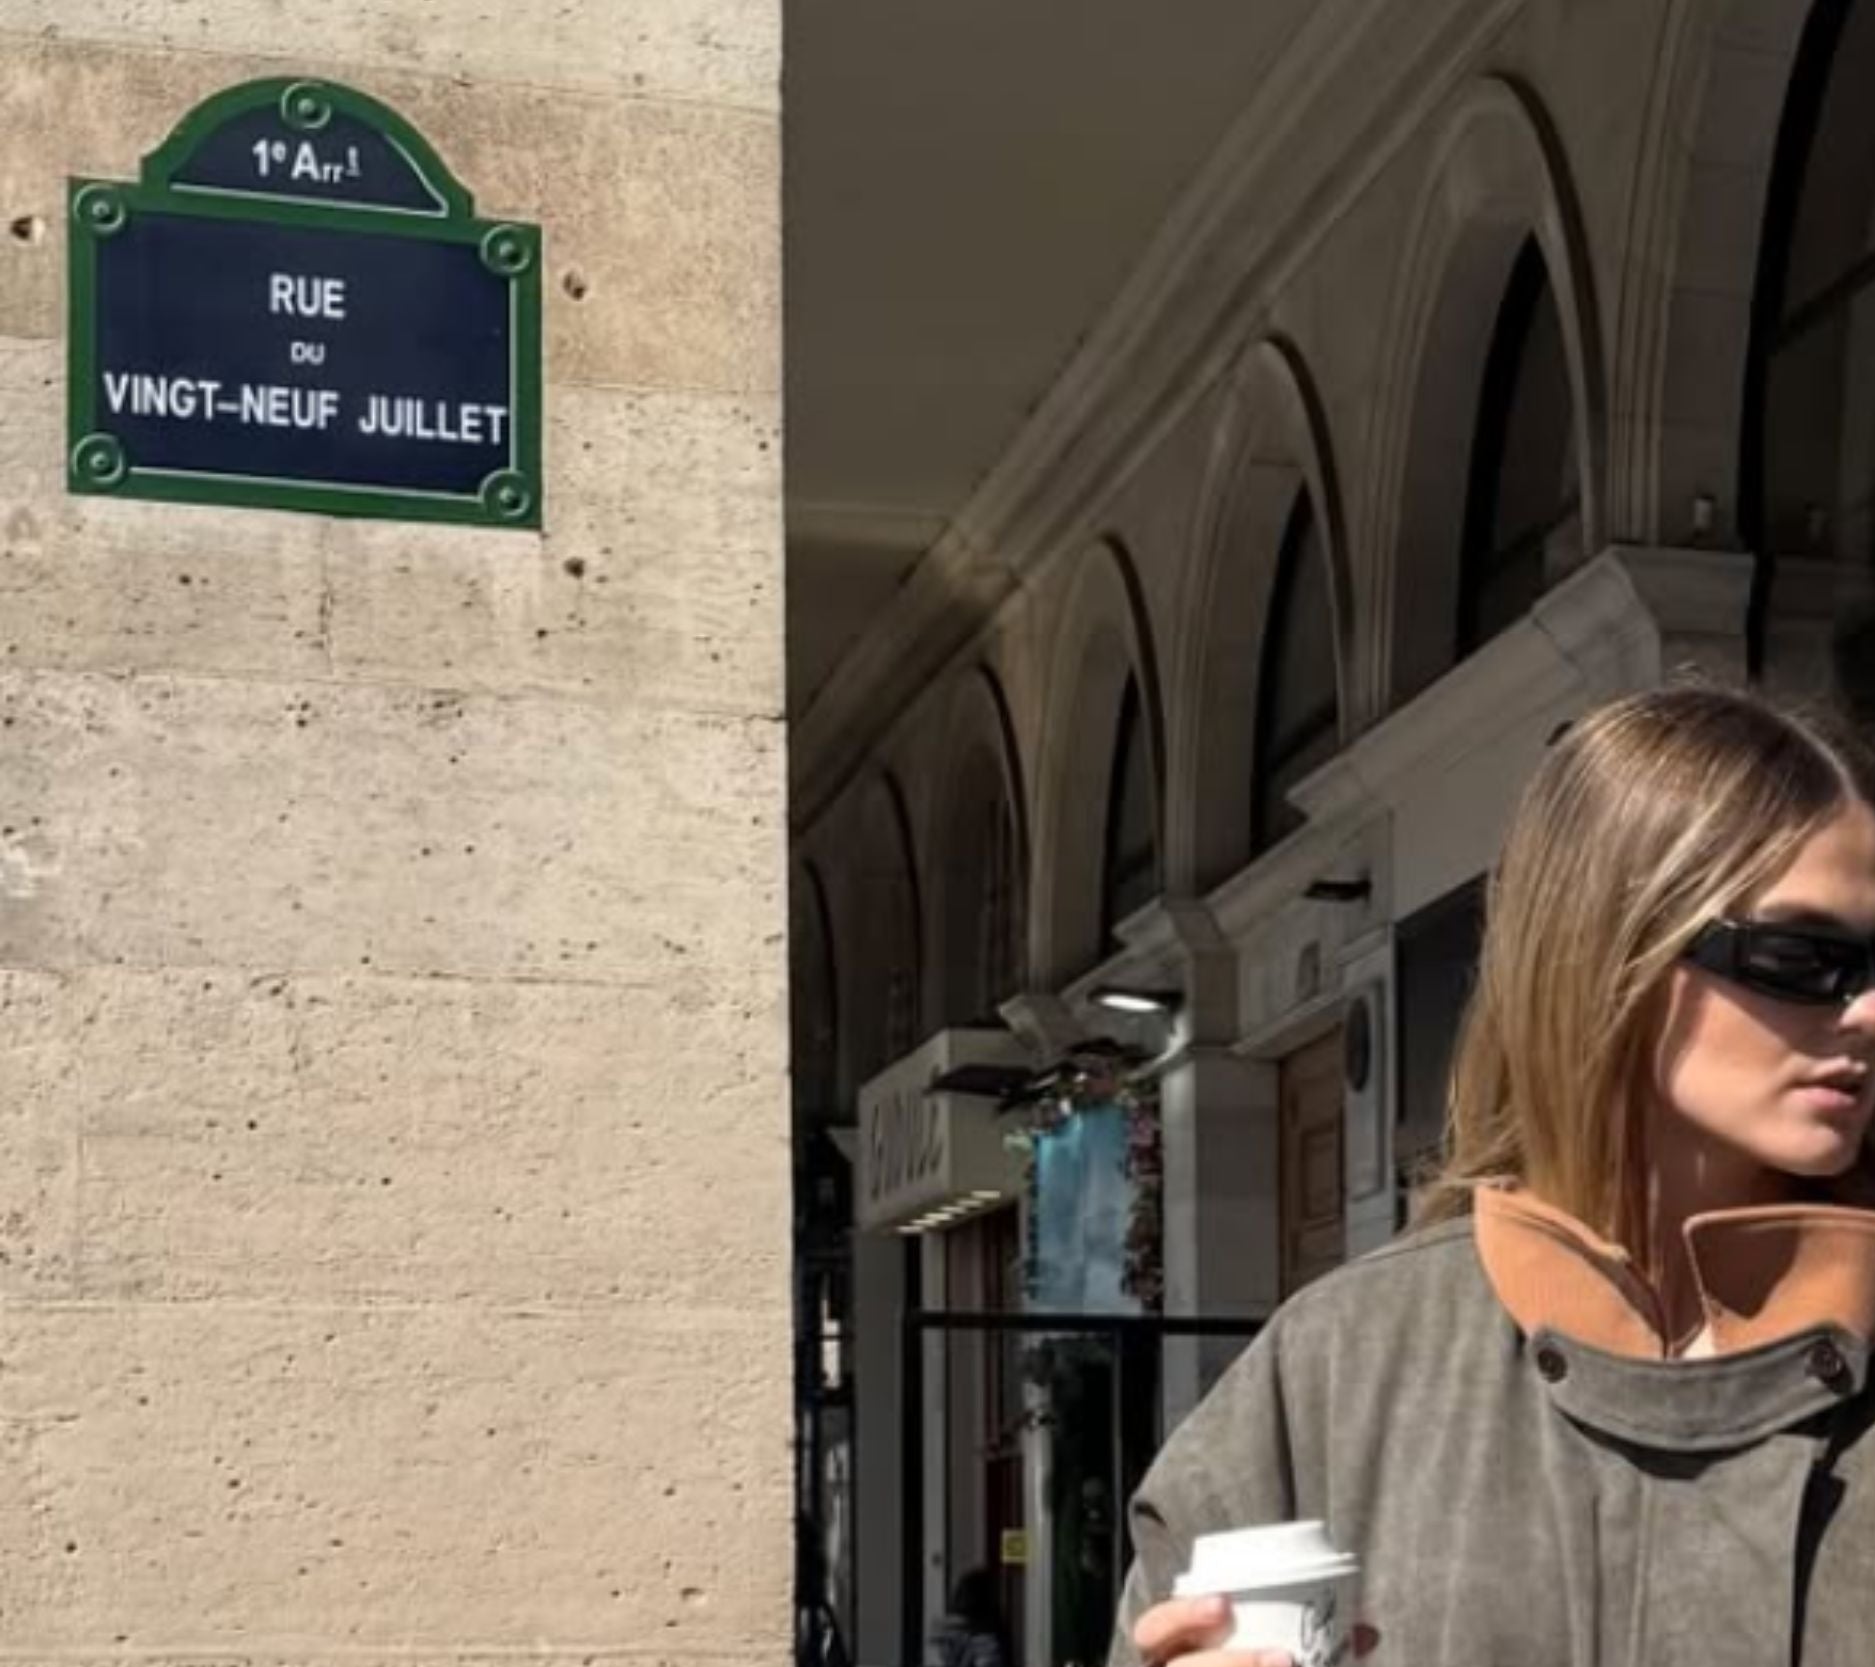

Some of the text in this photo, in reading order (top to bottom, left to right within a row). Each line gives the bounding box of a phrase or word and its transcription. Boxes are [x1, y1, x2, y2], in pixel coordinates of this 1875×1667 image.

[270, 273, 345, 319] RUE
[290, 341, 325, 365] DU
[103, 372, 507, 444] VINGT-NEUF JUILLET
